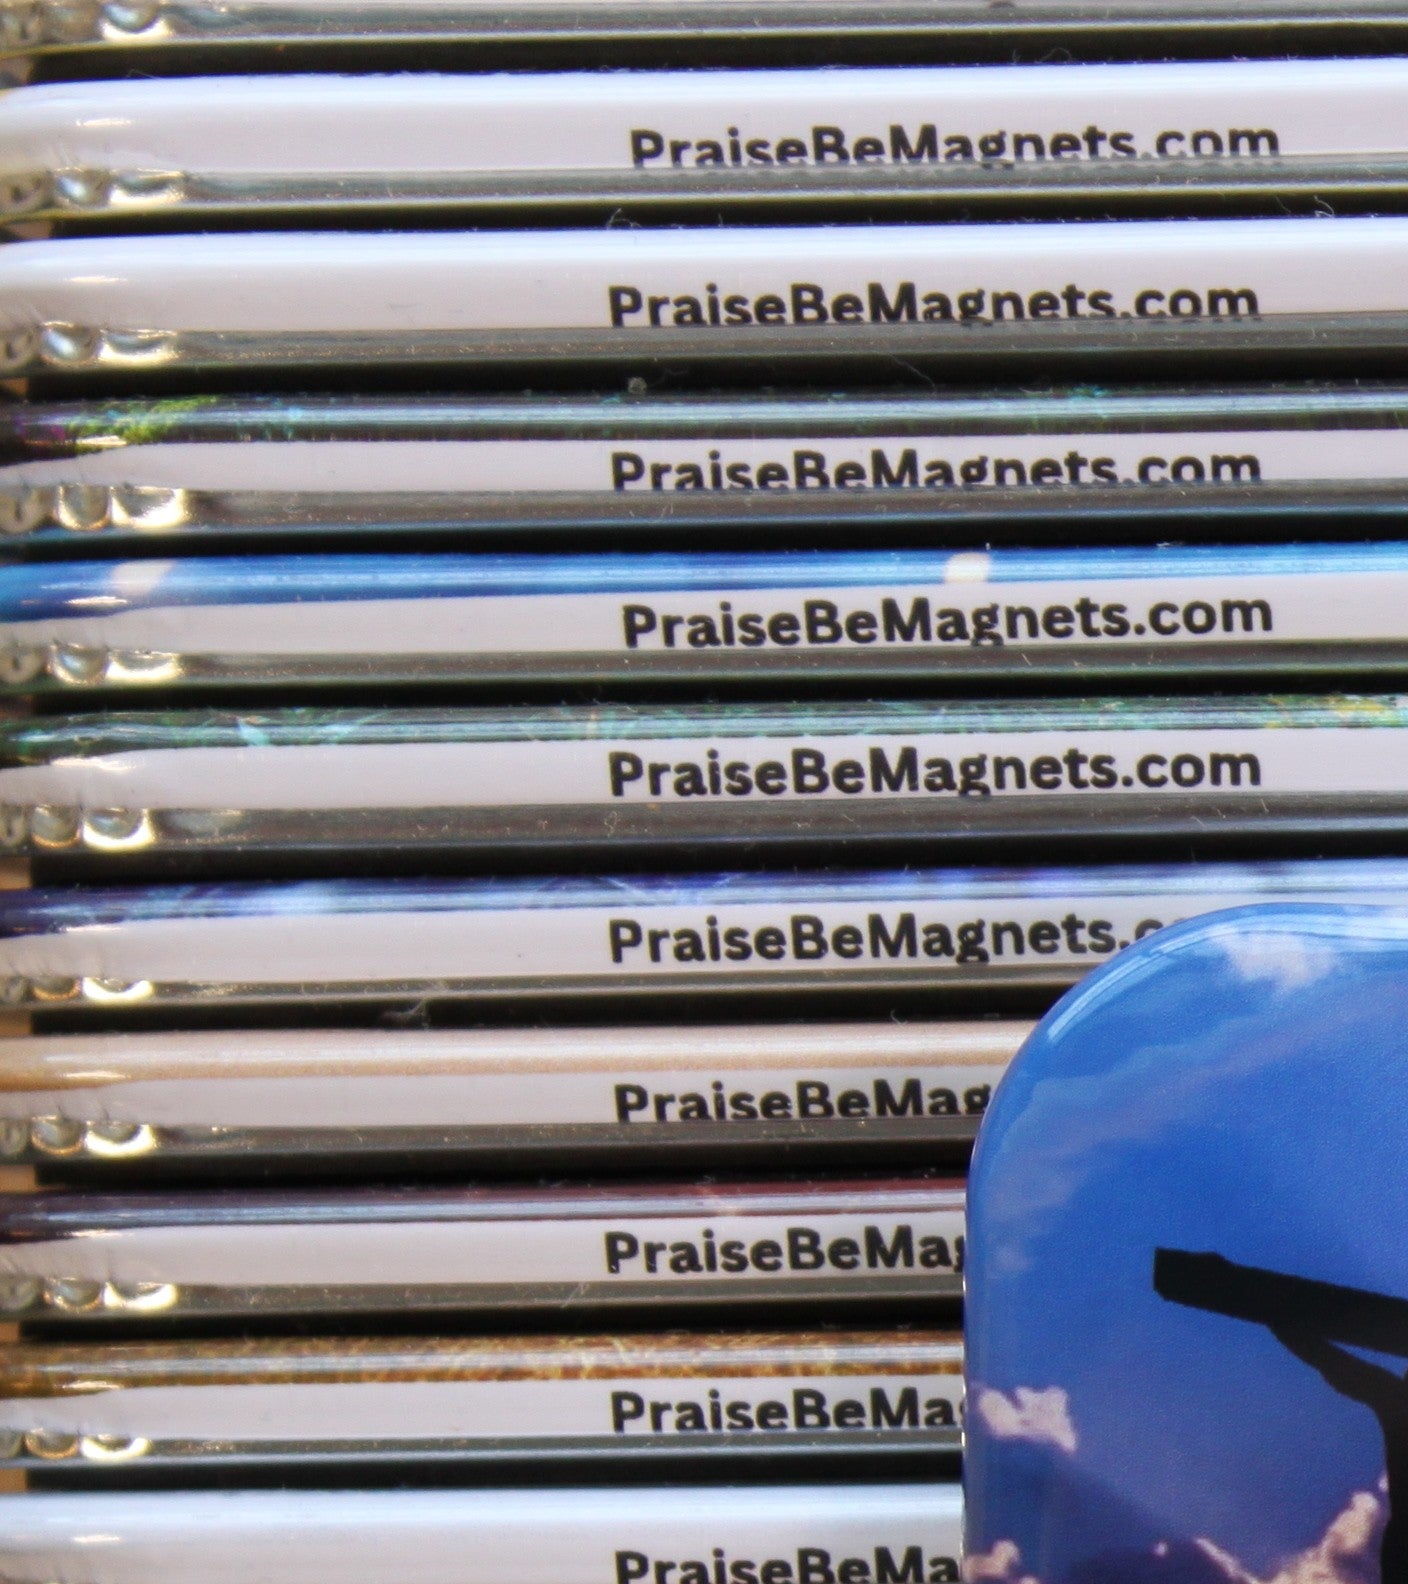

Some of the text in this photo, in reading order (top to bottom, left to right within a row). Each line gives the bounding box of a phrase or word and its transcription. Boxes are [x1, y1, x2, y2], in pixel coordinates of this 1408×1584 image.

[631, 125, 1280, 168] PraiseBeMagnets.com
[608, 281, 1260, 328] PraiseBeMagnets.com
[611, 448, 1262, 492] PraiseBeMagnets.com
[622, 596, 1274, 649] PraiseBeMagnets.com
[608, 743, 1262, 798] PraiseBeMagnets.com
[614, 1079, 991, 1124] PraiseBeMag
[610, 1388, 964, 1433] PraiseBeMa
